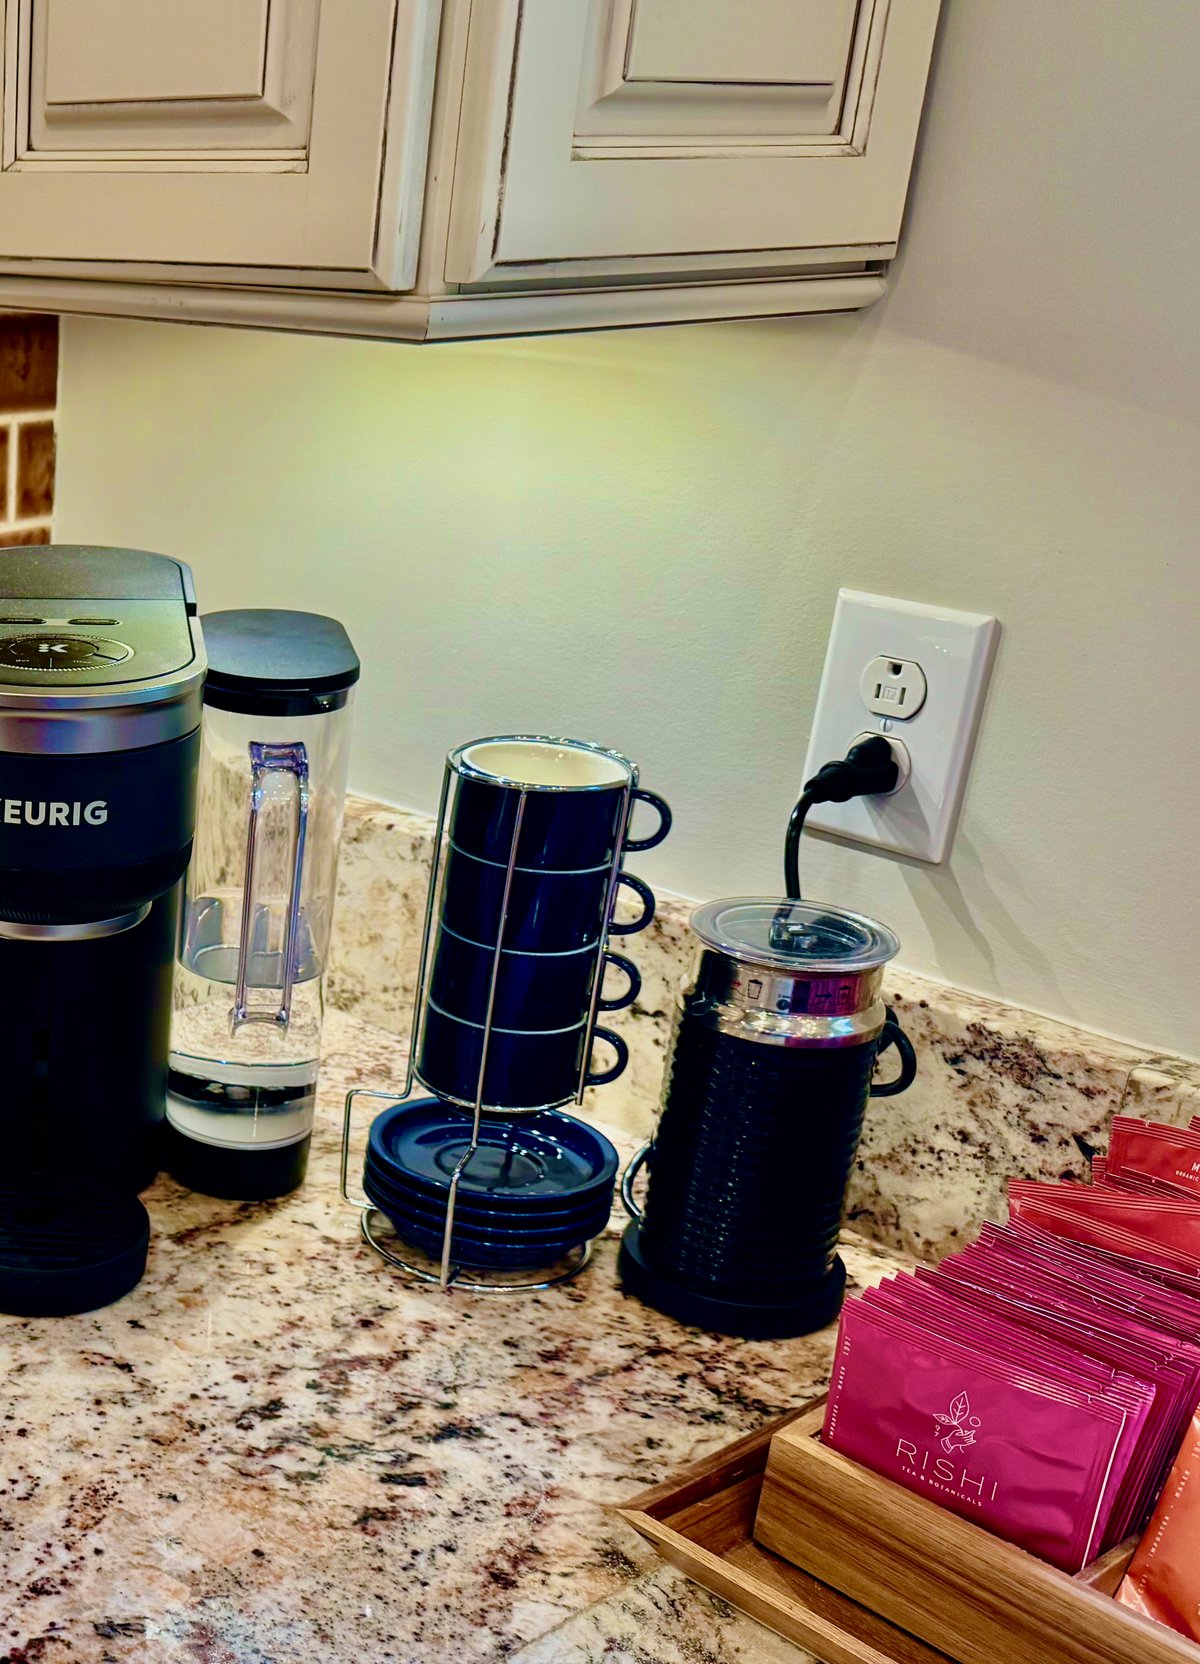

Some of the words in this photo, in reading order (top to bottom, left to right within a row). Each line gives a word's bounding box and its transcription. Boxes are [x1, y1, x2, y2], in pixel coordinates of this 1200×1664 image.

[896, 1438, 998, 1501] RISHI
[902, 1465, 917, 1477] TEA
[928, 1478, 982, 1507] BOTANICALS
